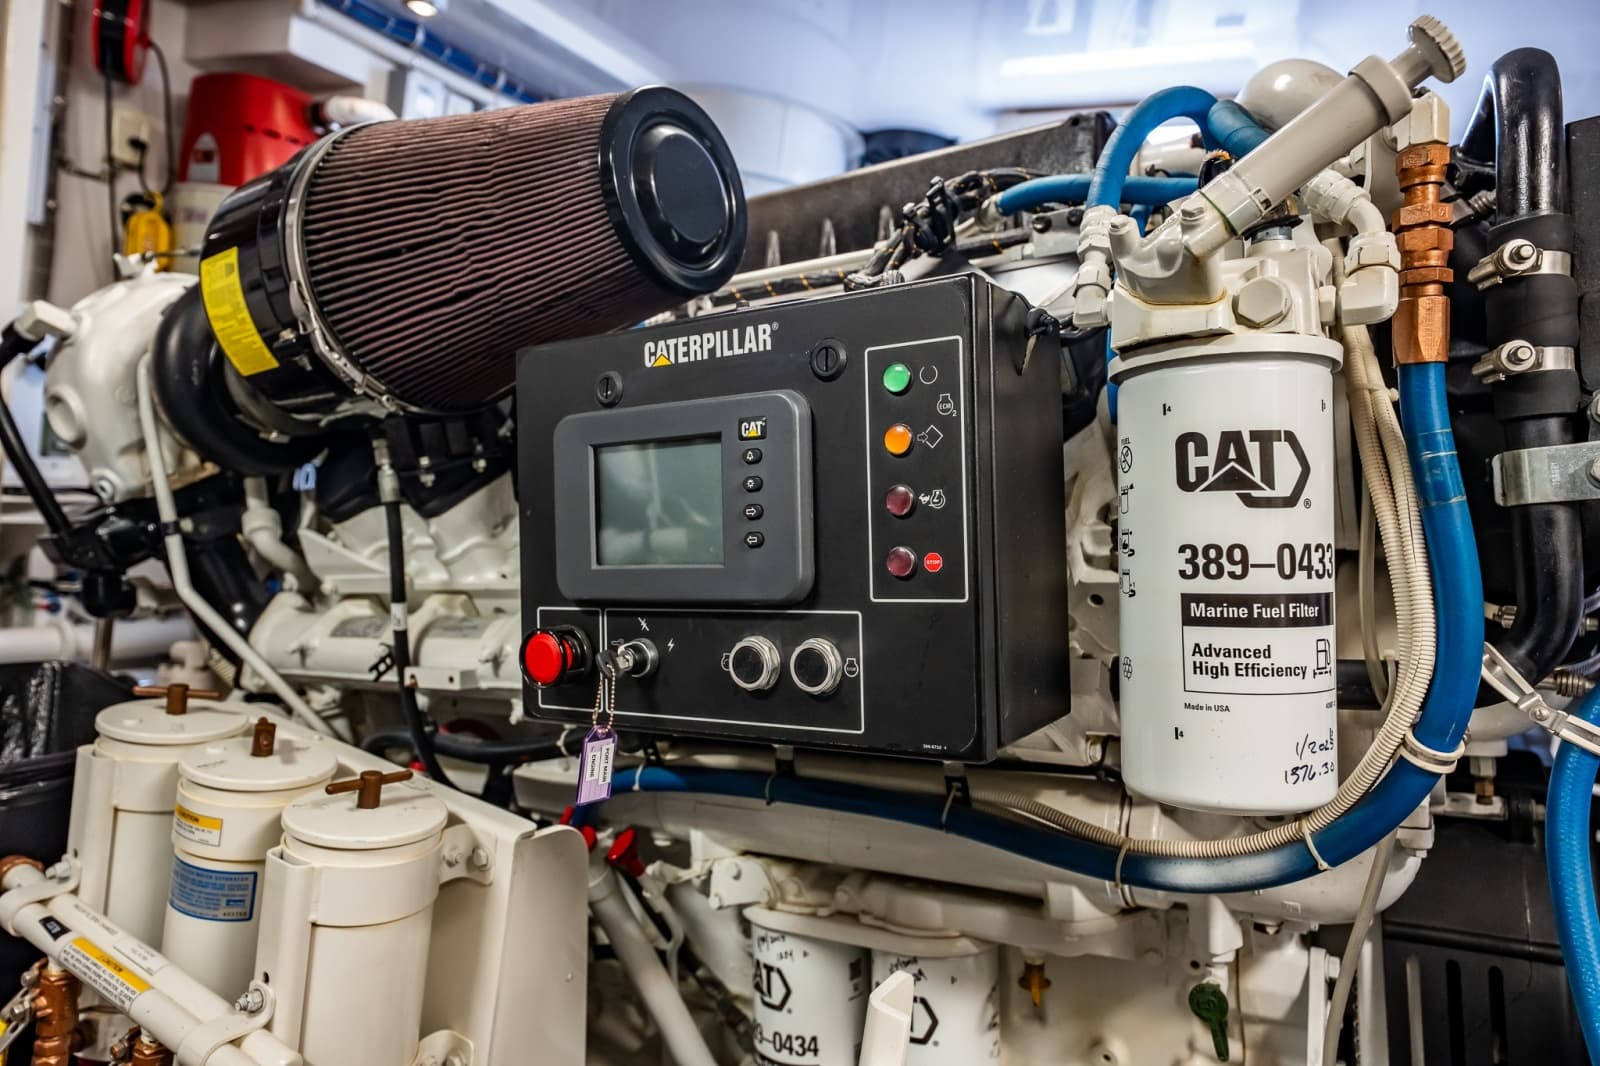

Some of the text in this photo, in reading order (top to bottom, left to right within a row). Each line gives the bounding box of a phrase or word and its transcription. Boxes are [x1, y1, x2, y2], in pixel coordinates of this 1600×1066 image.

[644, 323, 772, 367] CATERPILLAR
[741, 420, 763, 437] CAT
[1190, 602, 1319, 618] Marine Fuel Filter
[1192, 643, 1272, 659] Advanced
[1192, 661, 1308, 680] High Efficiency
[1184, 702, 1231, 713] Made in USA
